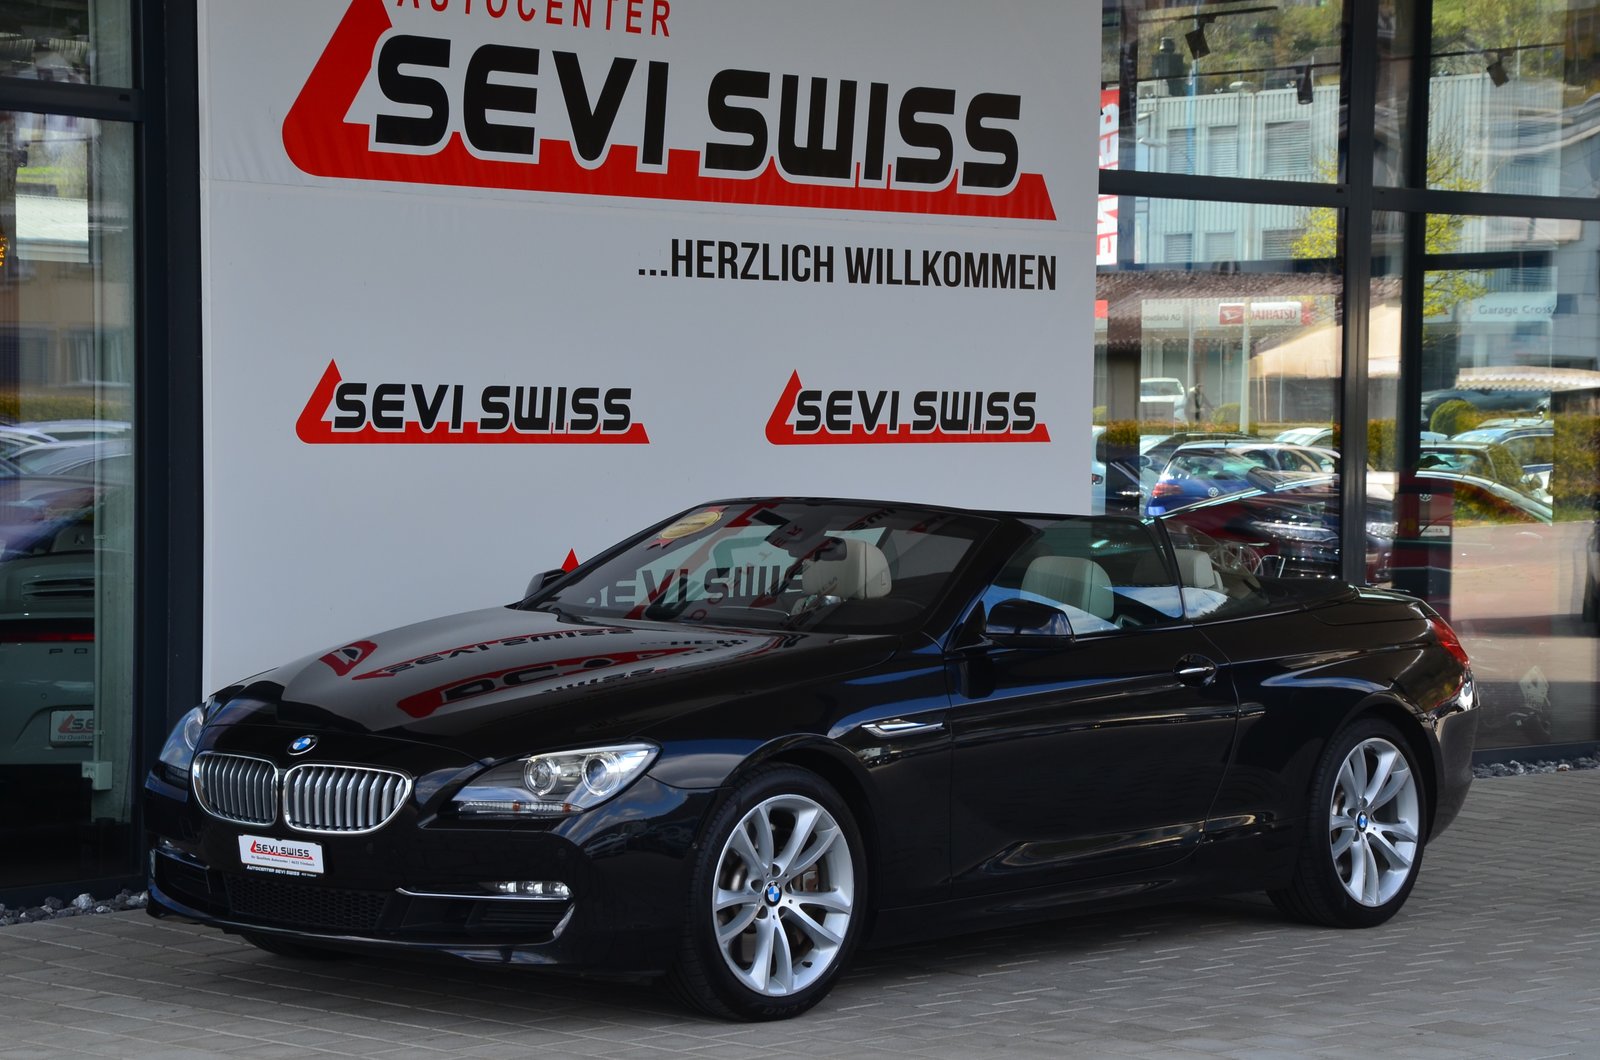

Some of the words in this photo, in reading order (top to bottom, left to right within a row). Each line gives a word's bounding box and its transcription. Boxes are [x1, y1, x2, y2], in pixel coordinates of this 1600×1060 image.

[397, 0, 671, 38] OCENTER
[373, 34, 669, 166] SEVI
[704, 68, 1022, 189] SWISS
[844, 246, 1057, 291] WILLKOMMEN
[1478, 304, 1518, 317] Garage
[334, 382, 464, 430] SEVI
[479, 385, 632, 431] SWISS
[795, 390, 900, 432] SEVI
[912, 390, 1037, 431] SWISS
[586, 568, 689, 607] EVI
[255, 843, 278, 853] SEVI
[280, 846, 310, 857] SWISS
